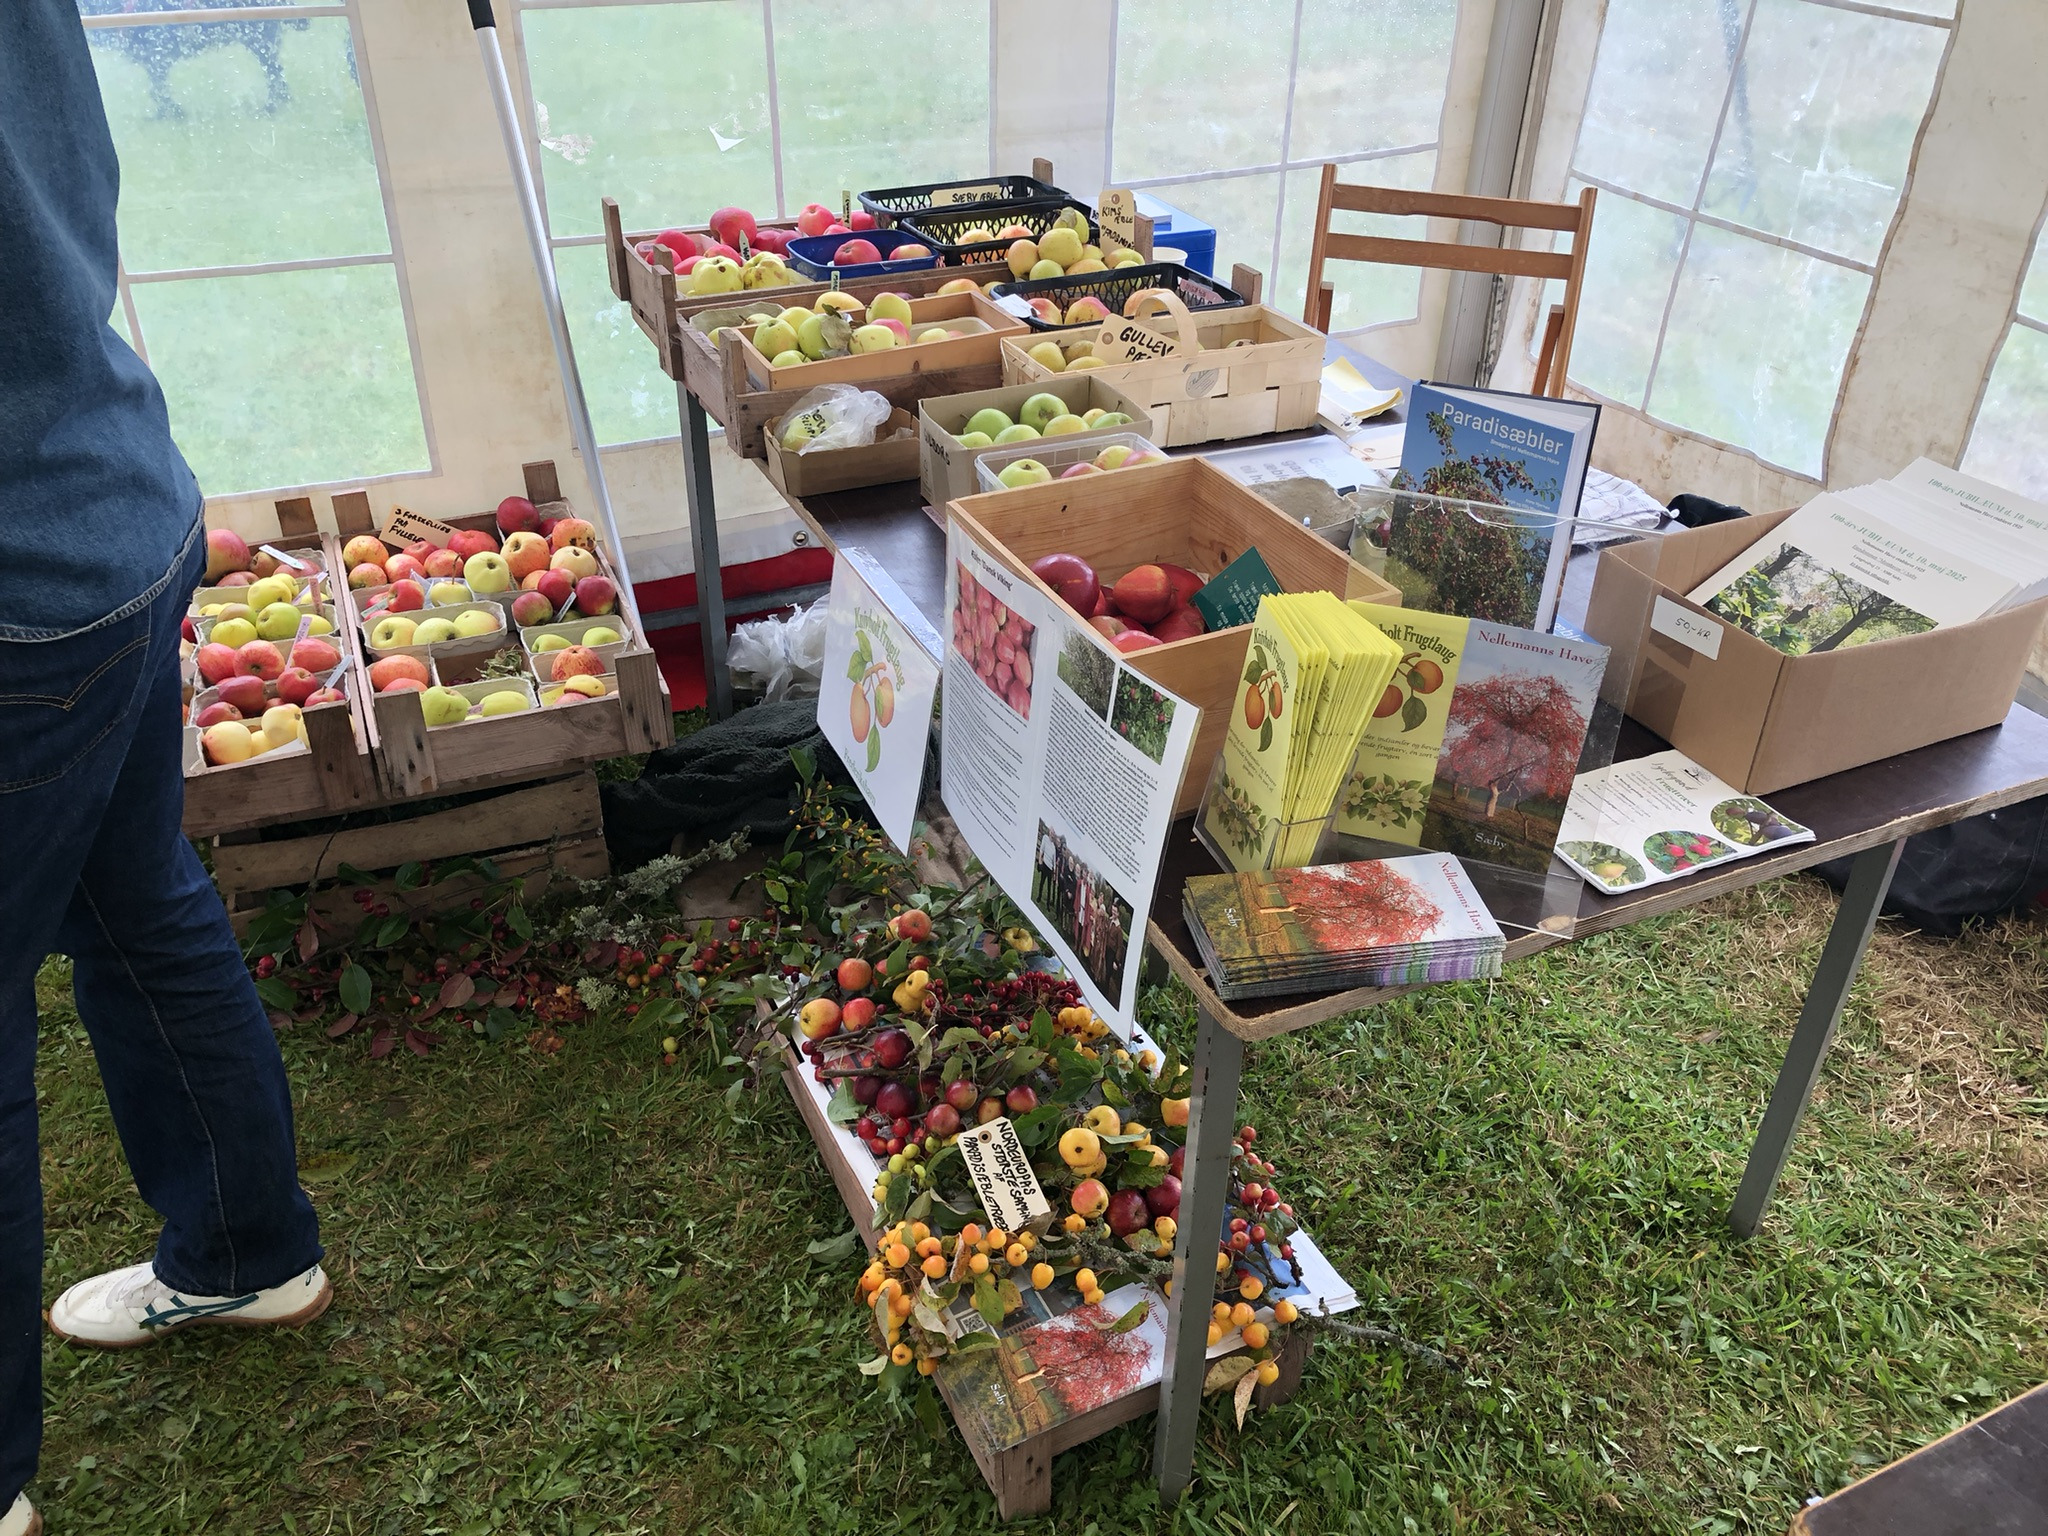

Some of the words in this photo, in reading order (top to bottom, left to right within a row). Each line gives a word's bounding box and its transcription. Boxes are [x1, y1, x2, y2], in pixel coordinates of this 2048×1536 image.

[1442, 402, 1564, 455] Paradisæbler
[1928, 562, 1947, 575] maj
[1946, 569, 1968, 583] 2025
[1378, 623, 1402, 641] holt
[1403, 624, 1457, 665] Frugtlaug
[1477, 629, 1555, 657] Nellemanns
[1557, 647, 1594, 666] Have
[1475, 832, 1507, 851] Sæby
[1438, 860, 1470, 909] Nellemanns
[1467, 909, 1485, 932] Have
[1224, 907, 1239, 928] Sæby
[991, 1143, 1021, 1189] STØRSTE
[996, 1121, 1036, 1196] NORDEUROPAS
